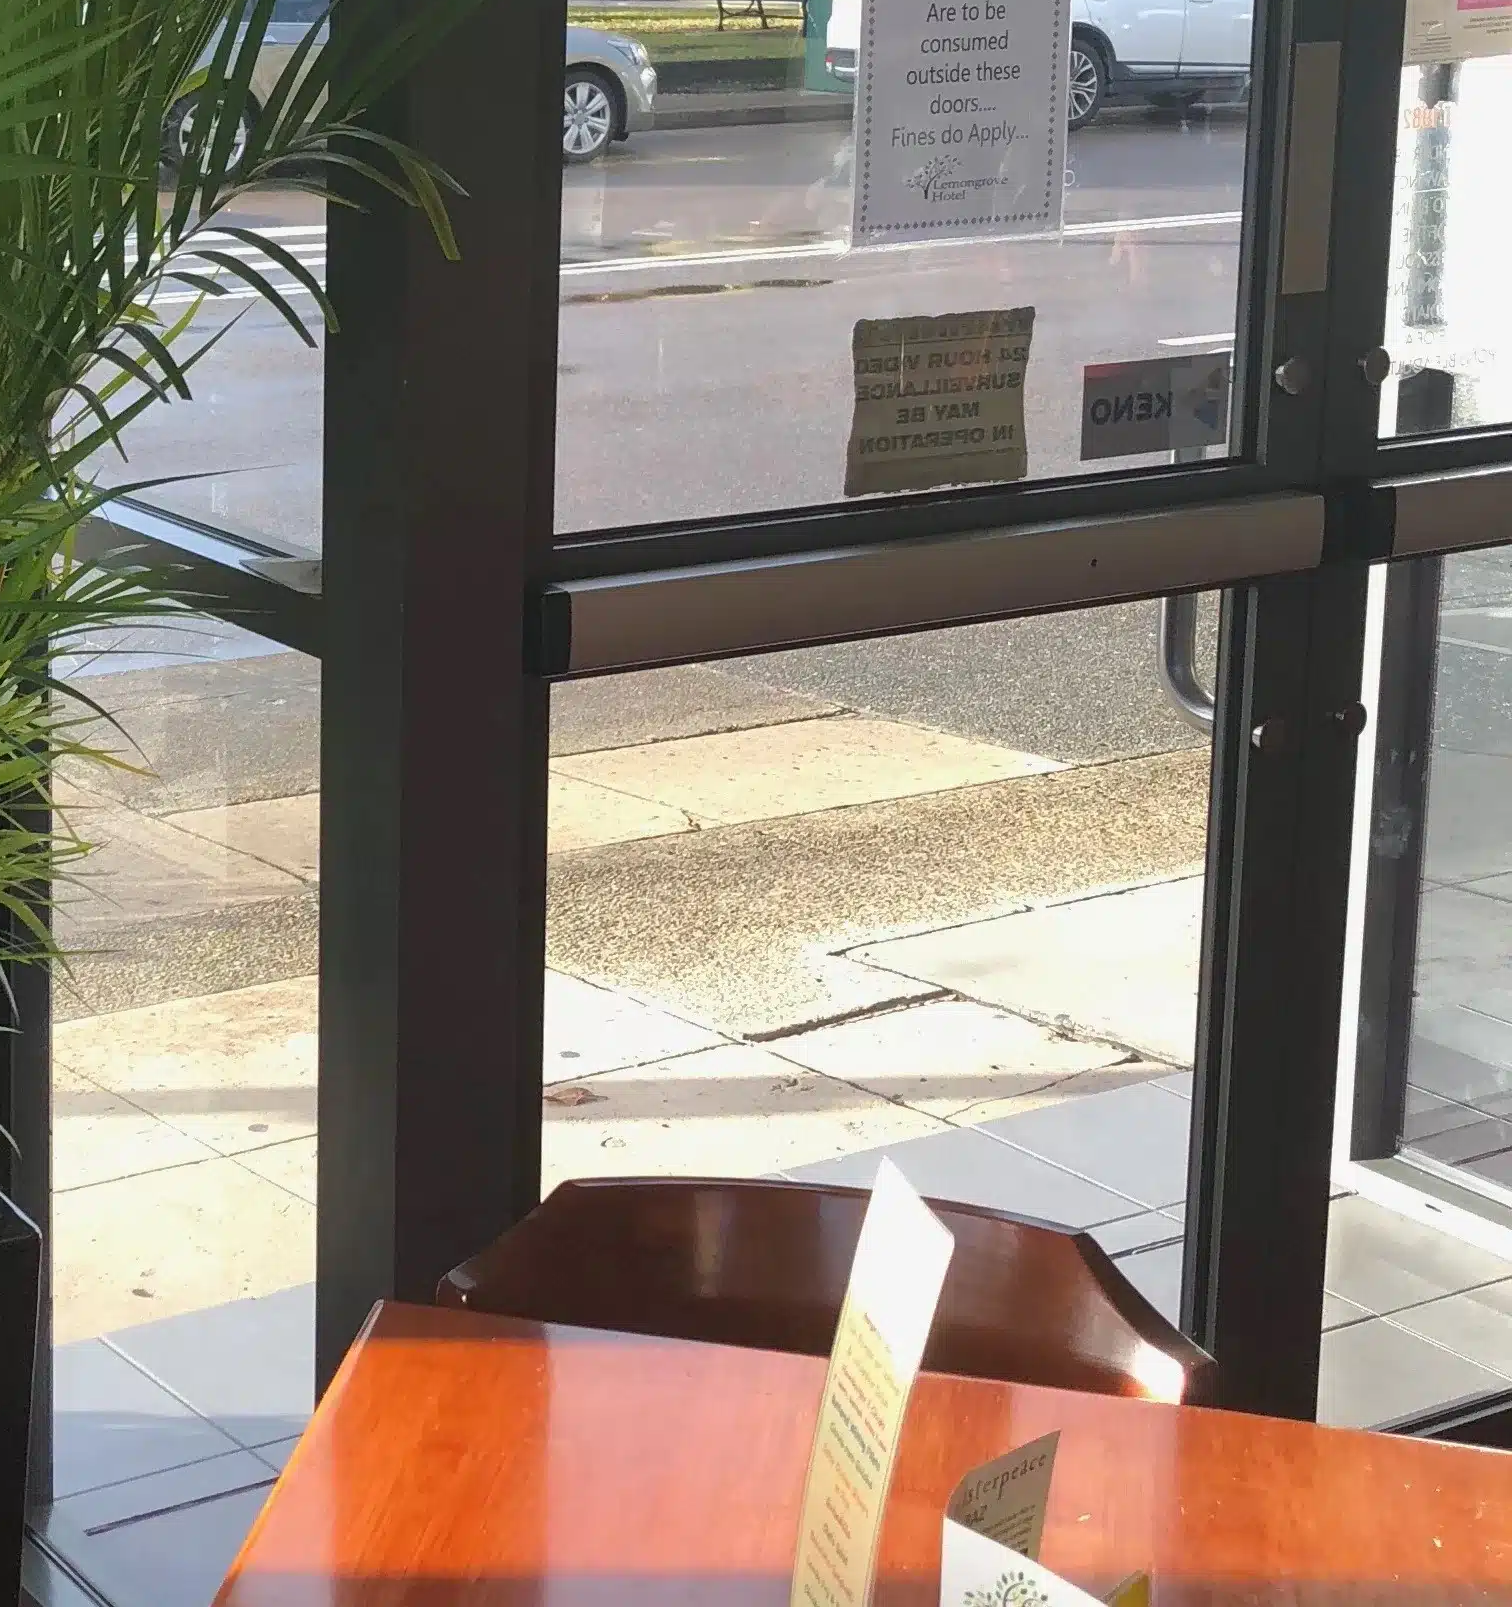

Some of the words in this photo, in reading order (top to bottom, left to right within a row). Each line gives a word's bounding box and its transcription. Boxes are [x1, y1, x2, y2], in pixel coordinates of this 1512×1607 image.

[926, 2, 956, 22] Are
[961, 2, 979, 21] to
[985, 0, 1006, 20] be
[920, 29, 1009, 53] consumed
[906, 62, 971, 85] outside
[976, 61, 1021, 81] these
[891, 126, 936, 147] Fines
[941, 124, 963, 144] do
[933, 175, 1009, 191] Lemongrove
[931, 189, 966, 203] Hotel
